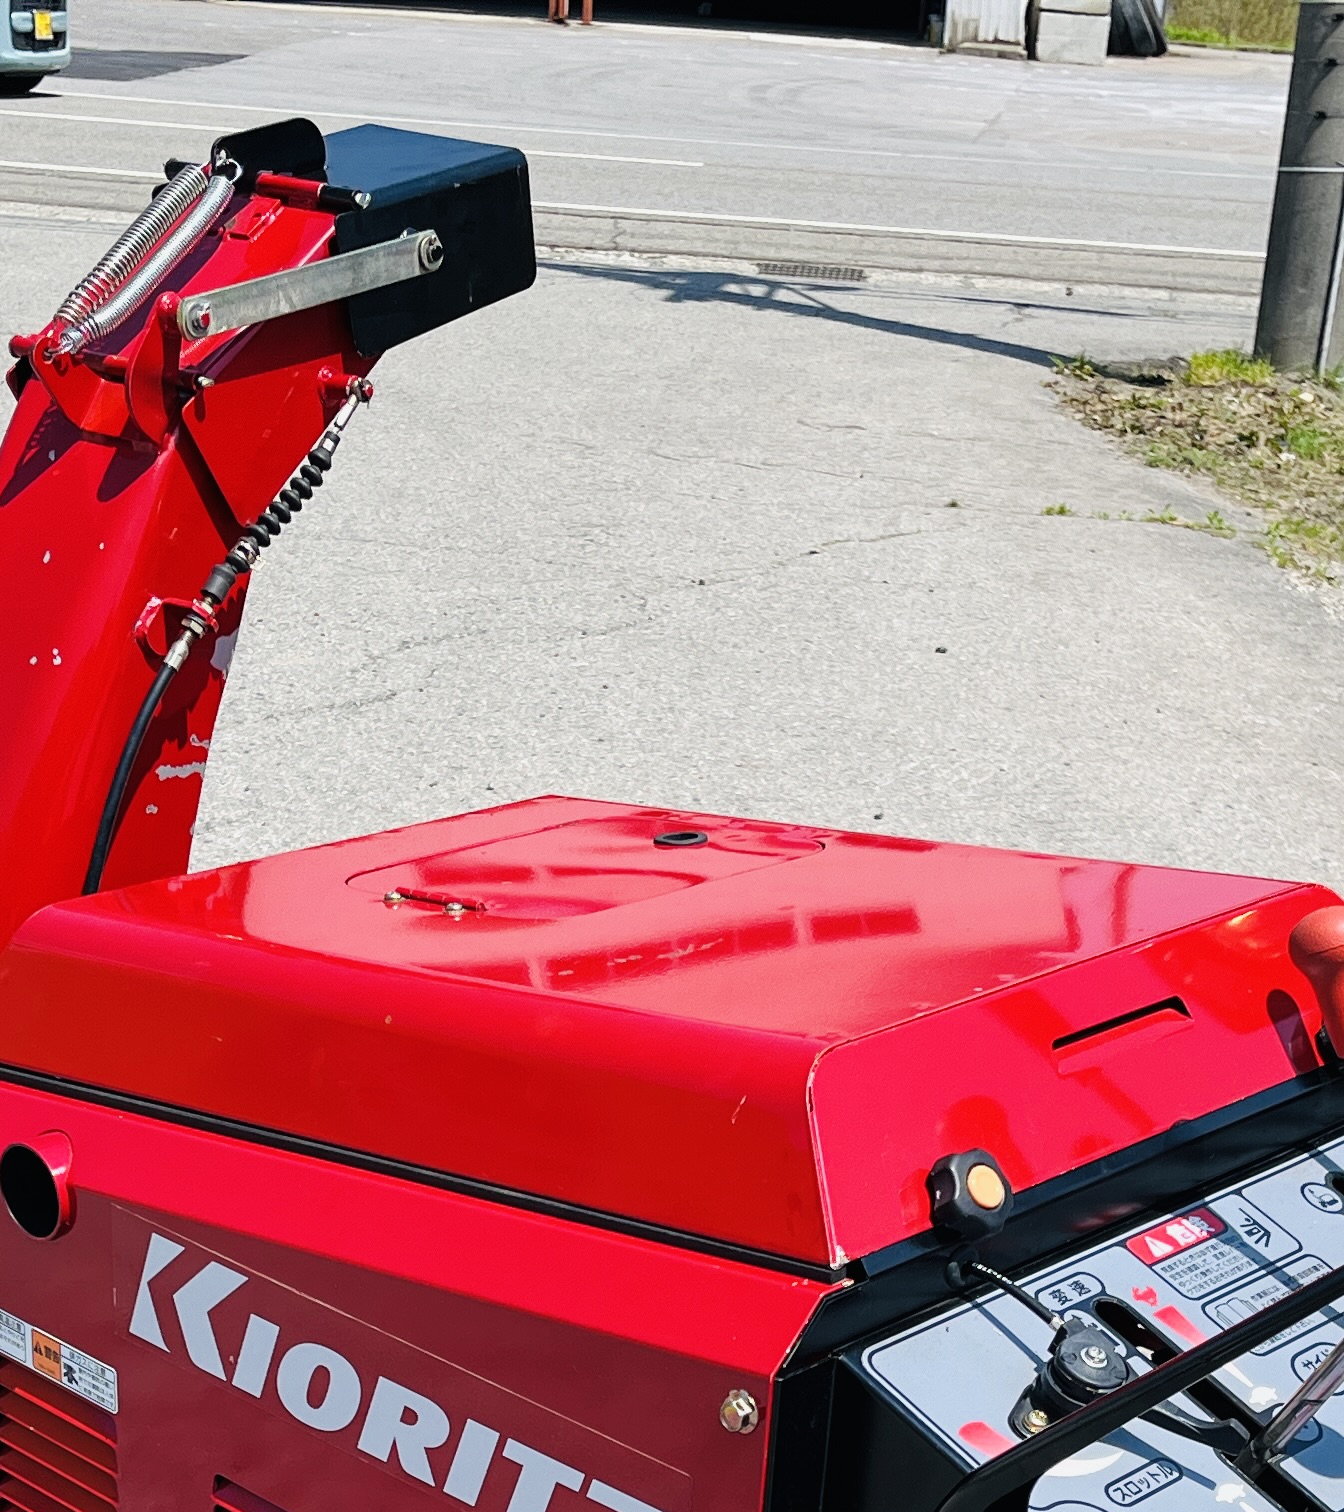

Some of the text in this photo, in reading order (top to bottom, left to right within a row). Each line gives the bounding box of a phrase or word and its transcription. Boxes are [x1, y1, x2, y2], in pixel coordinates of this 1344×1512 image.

[1166, 1215, 1216, 1247] 危険
[1048, 1279, 1092, 1306] 変速
[1112, 1464, 1176, 1503] スロットル
